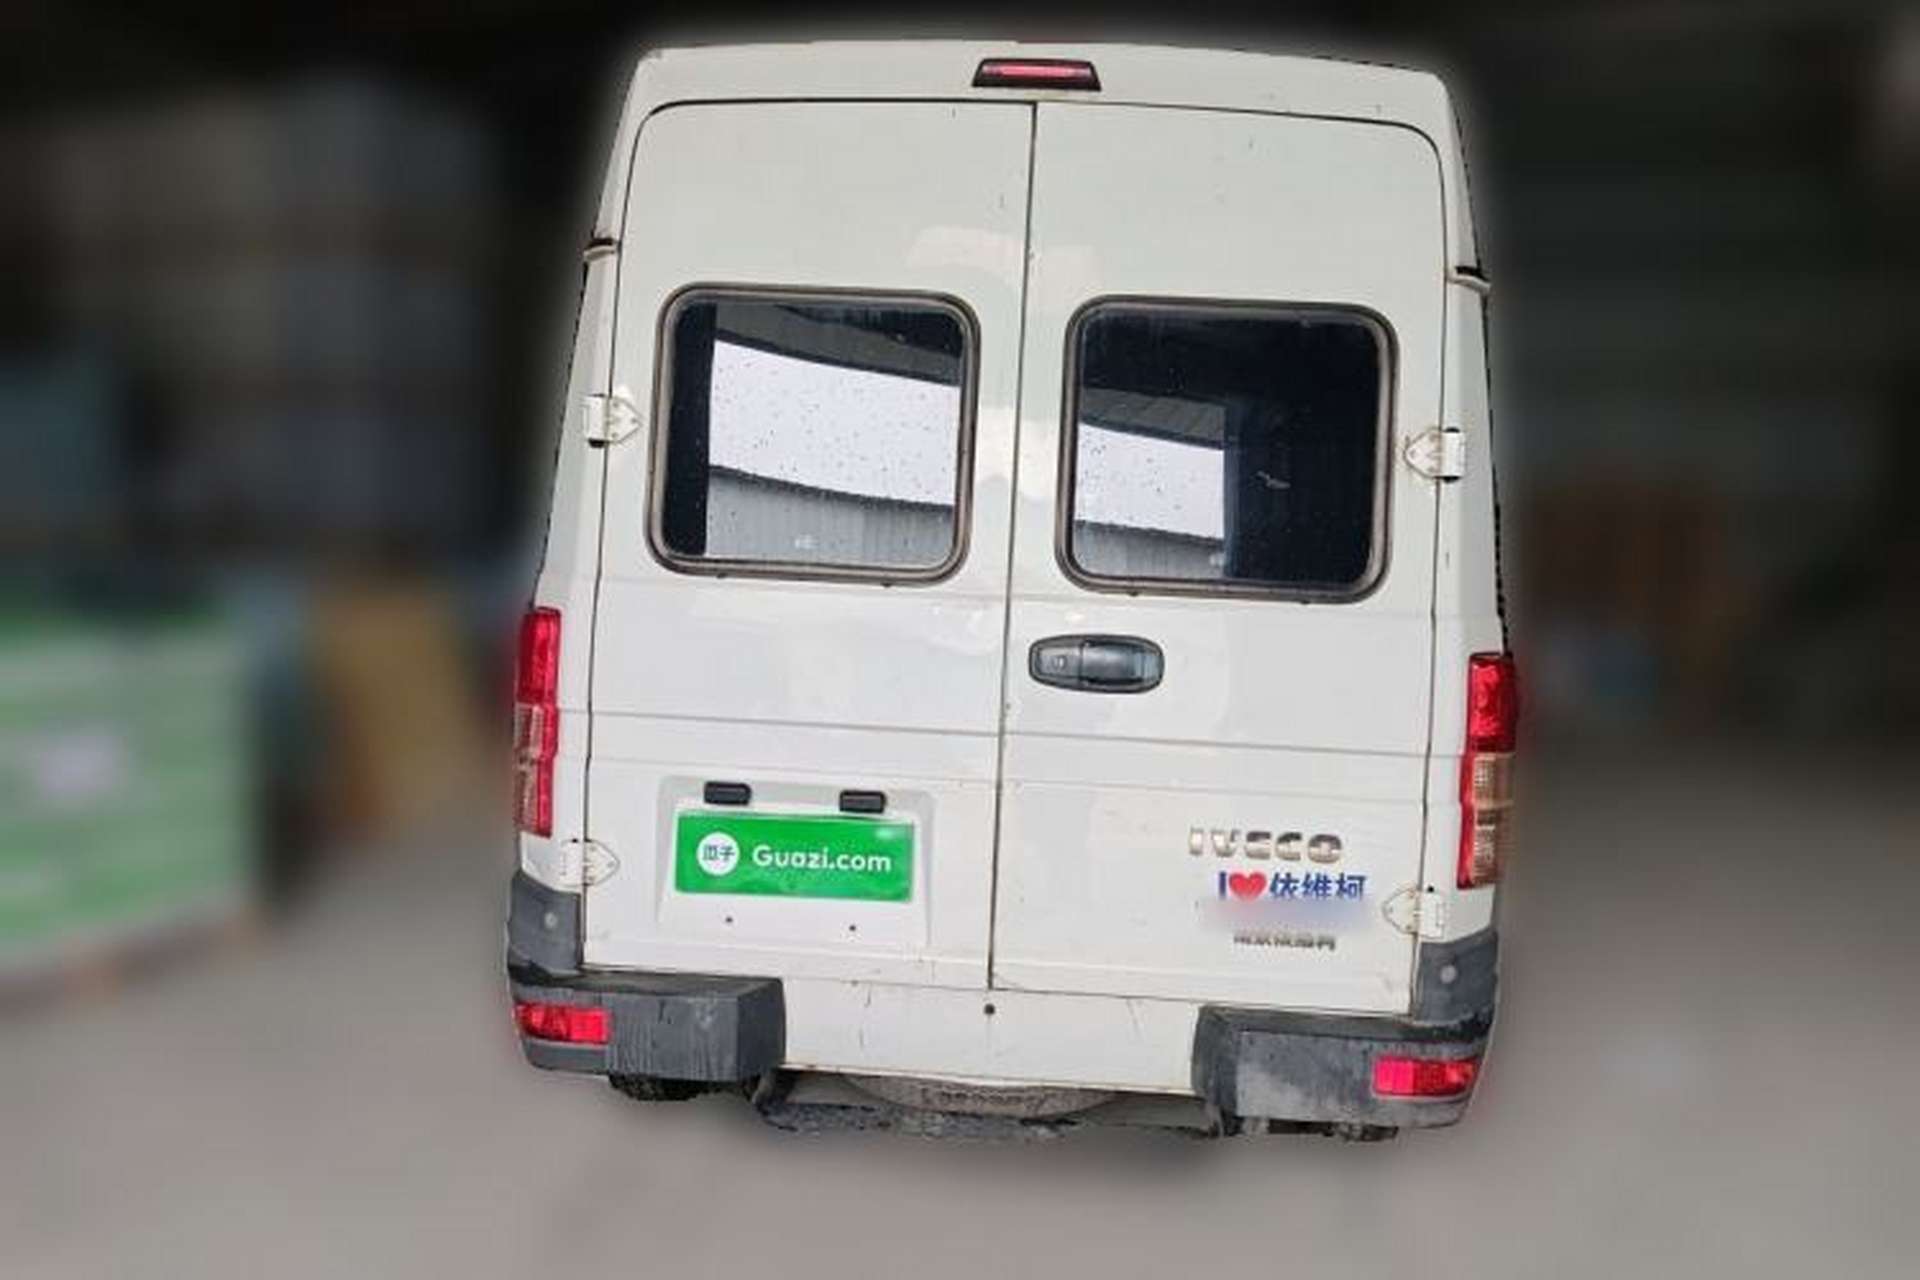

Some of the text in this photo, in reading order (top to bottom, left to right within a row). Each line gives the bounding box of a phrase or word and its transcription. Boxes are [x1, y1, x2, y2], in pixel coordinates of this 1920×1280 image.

[1189, 828, 1343, 864] IVECO
[1269, 871, 1368, 900] 依维柯
